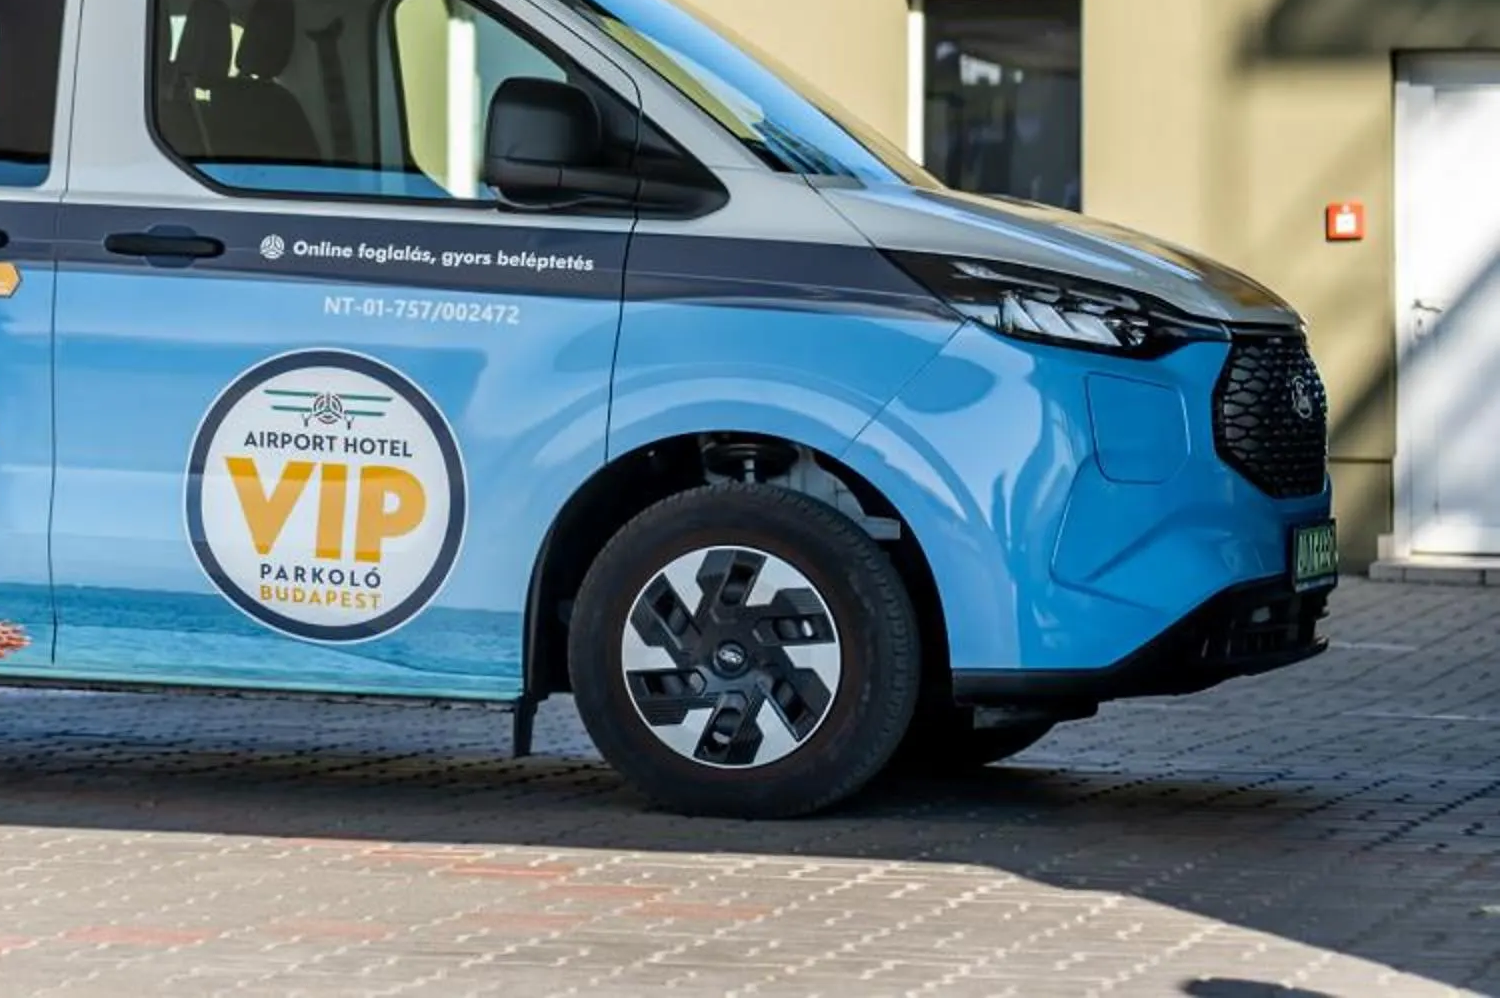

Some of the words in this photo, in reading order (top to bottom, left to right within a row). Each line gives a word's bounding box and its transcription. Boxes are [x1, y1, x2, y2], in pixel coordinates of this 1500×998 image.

[293, 240, 353, 258] Online
[358, 242, 436, 264] foglalás,
[441, 251, 492, 267] gyors
[497, 249, 594, 272] beléptetés
[323, 295, 521, 325] NT-01-757/002472
[244, 431, 337, 453] AIRPORT
[343, 436, 413, 458] HOTEL
[224, 456, 427, 563] VIP
[260, 563, 381, 589] PARKOLÓ
[260, 585, 382, 611] BUDAPEST
